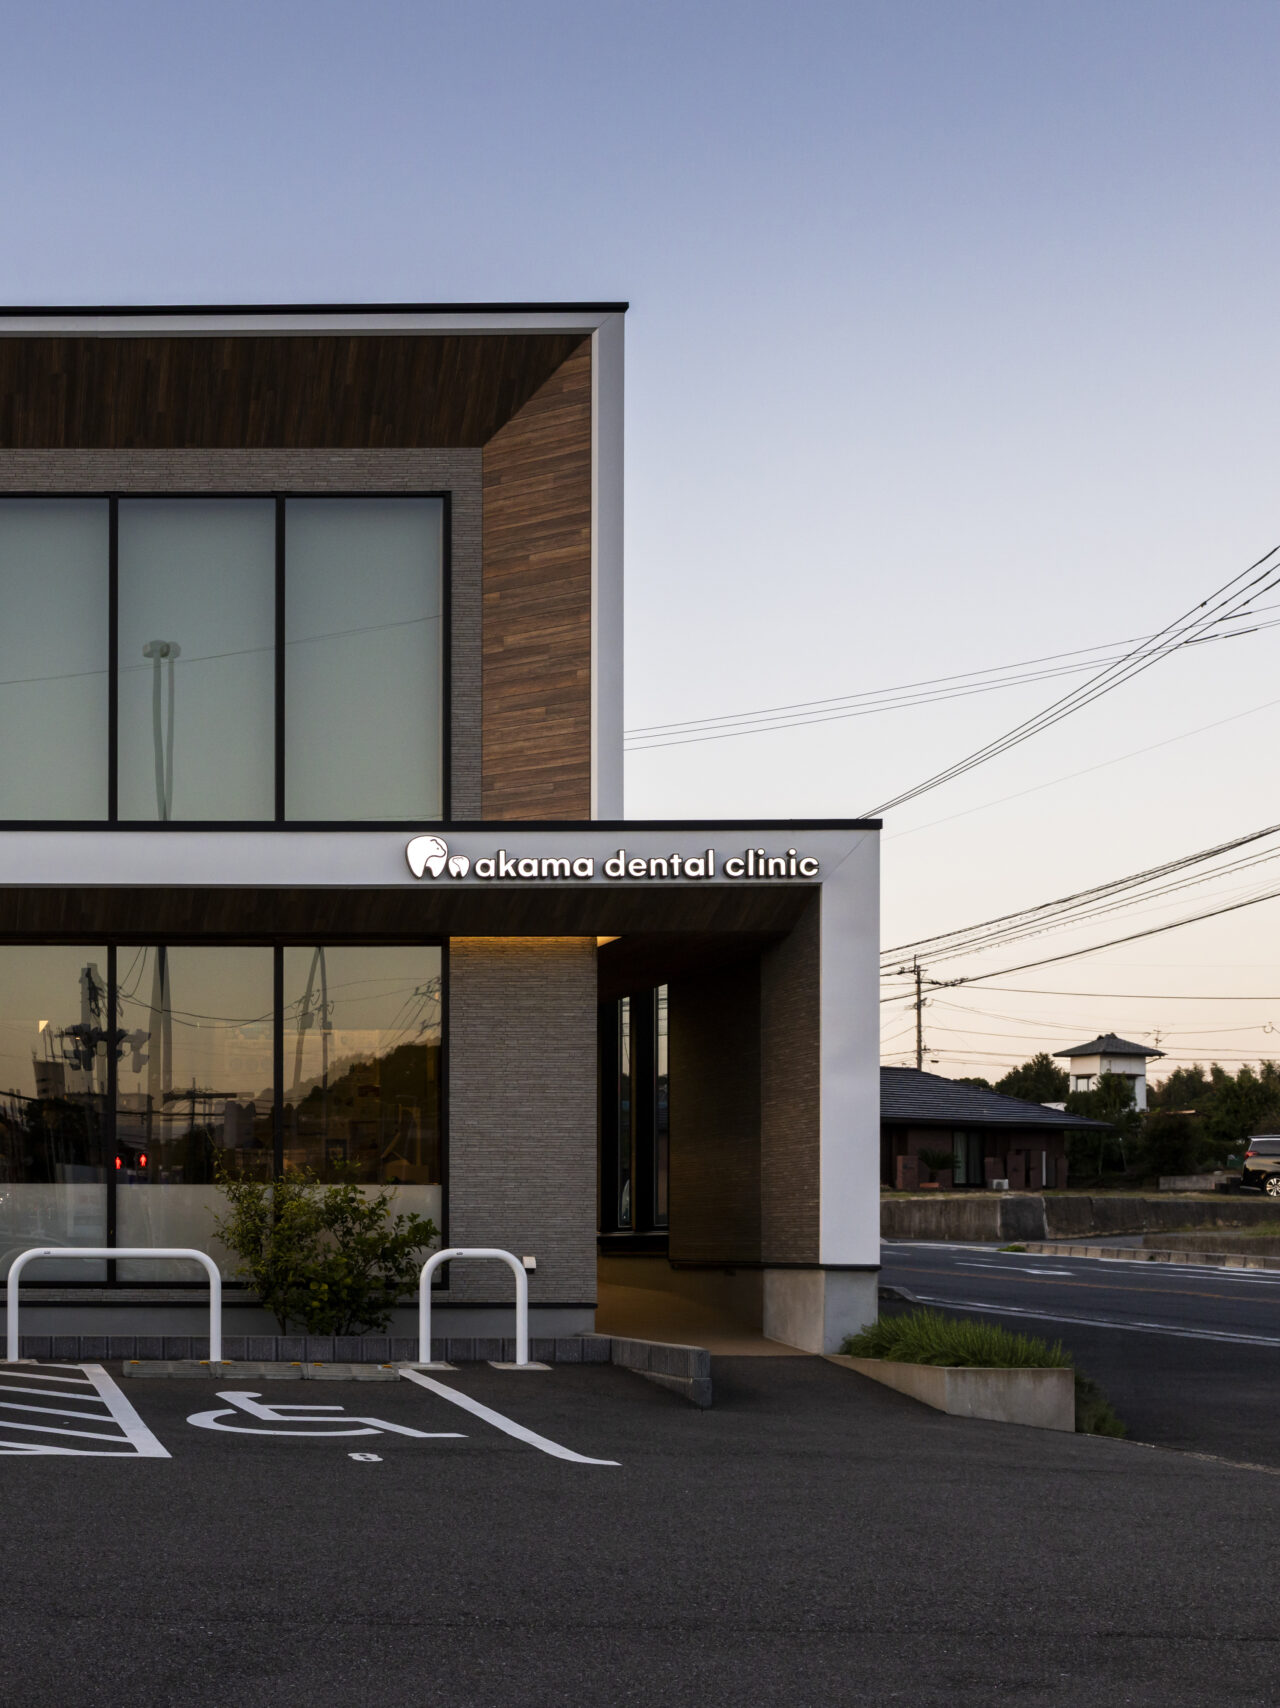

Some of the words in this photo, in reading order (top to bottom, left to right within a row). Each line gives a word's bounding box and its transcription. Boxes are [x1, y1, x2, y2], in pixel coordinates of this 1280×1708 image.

[474, 849, 594, 879] akama
[603, 849, 715, 878] dental
[724, 848, 820, 878] clinic
[346, 1452, 384, 1462] 8
